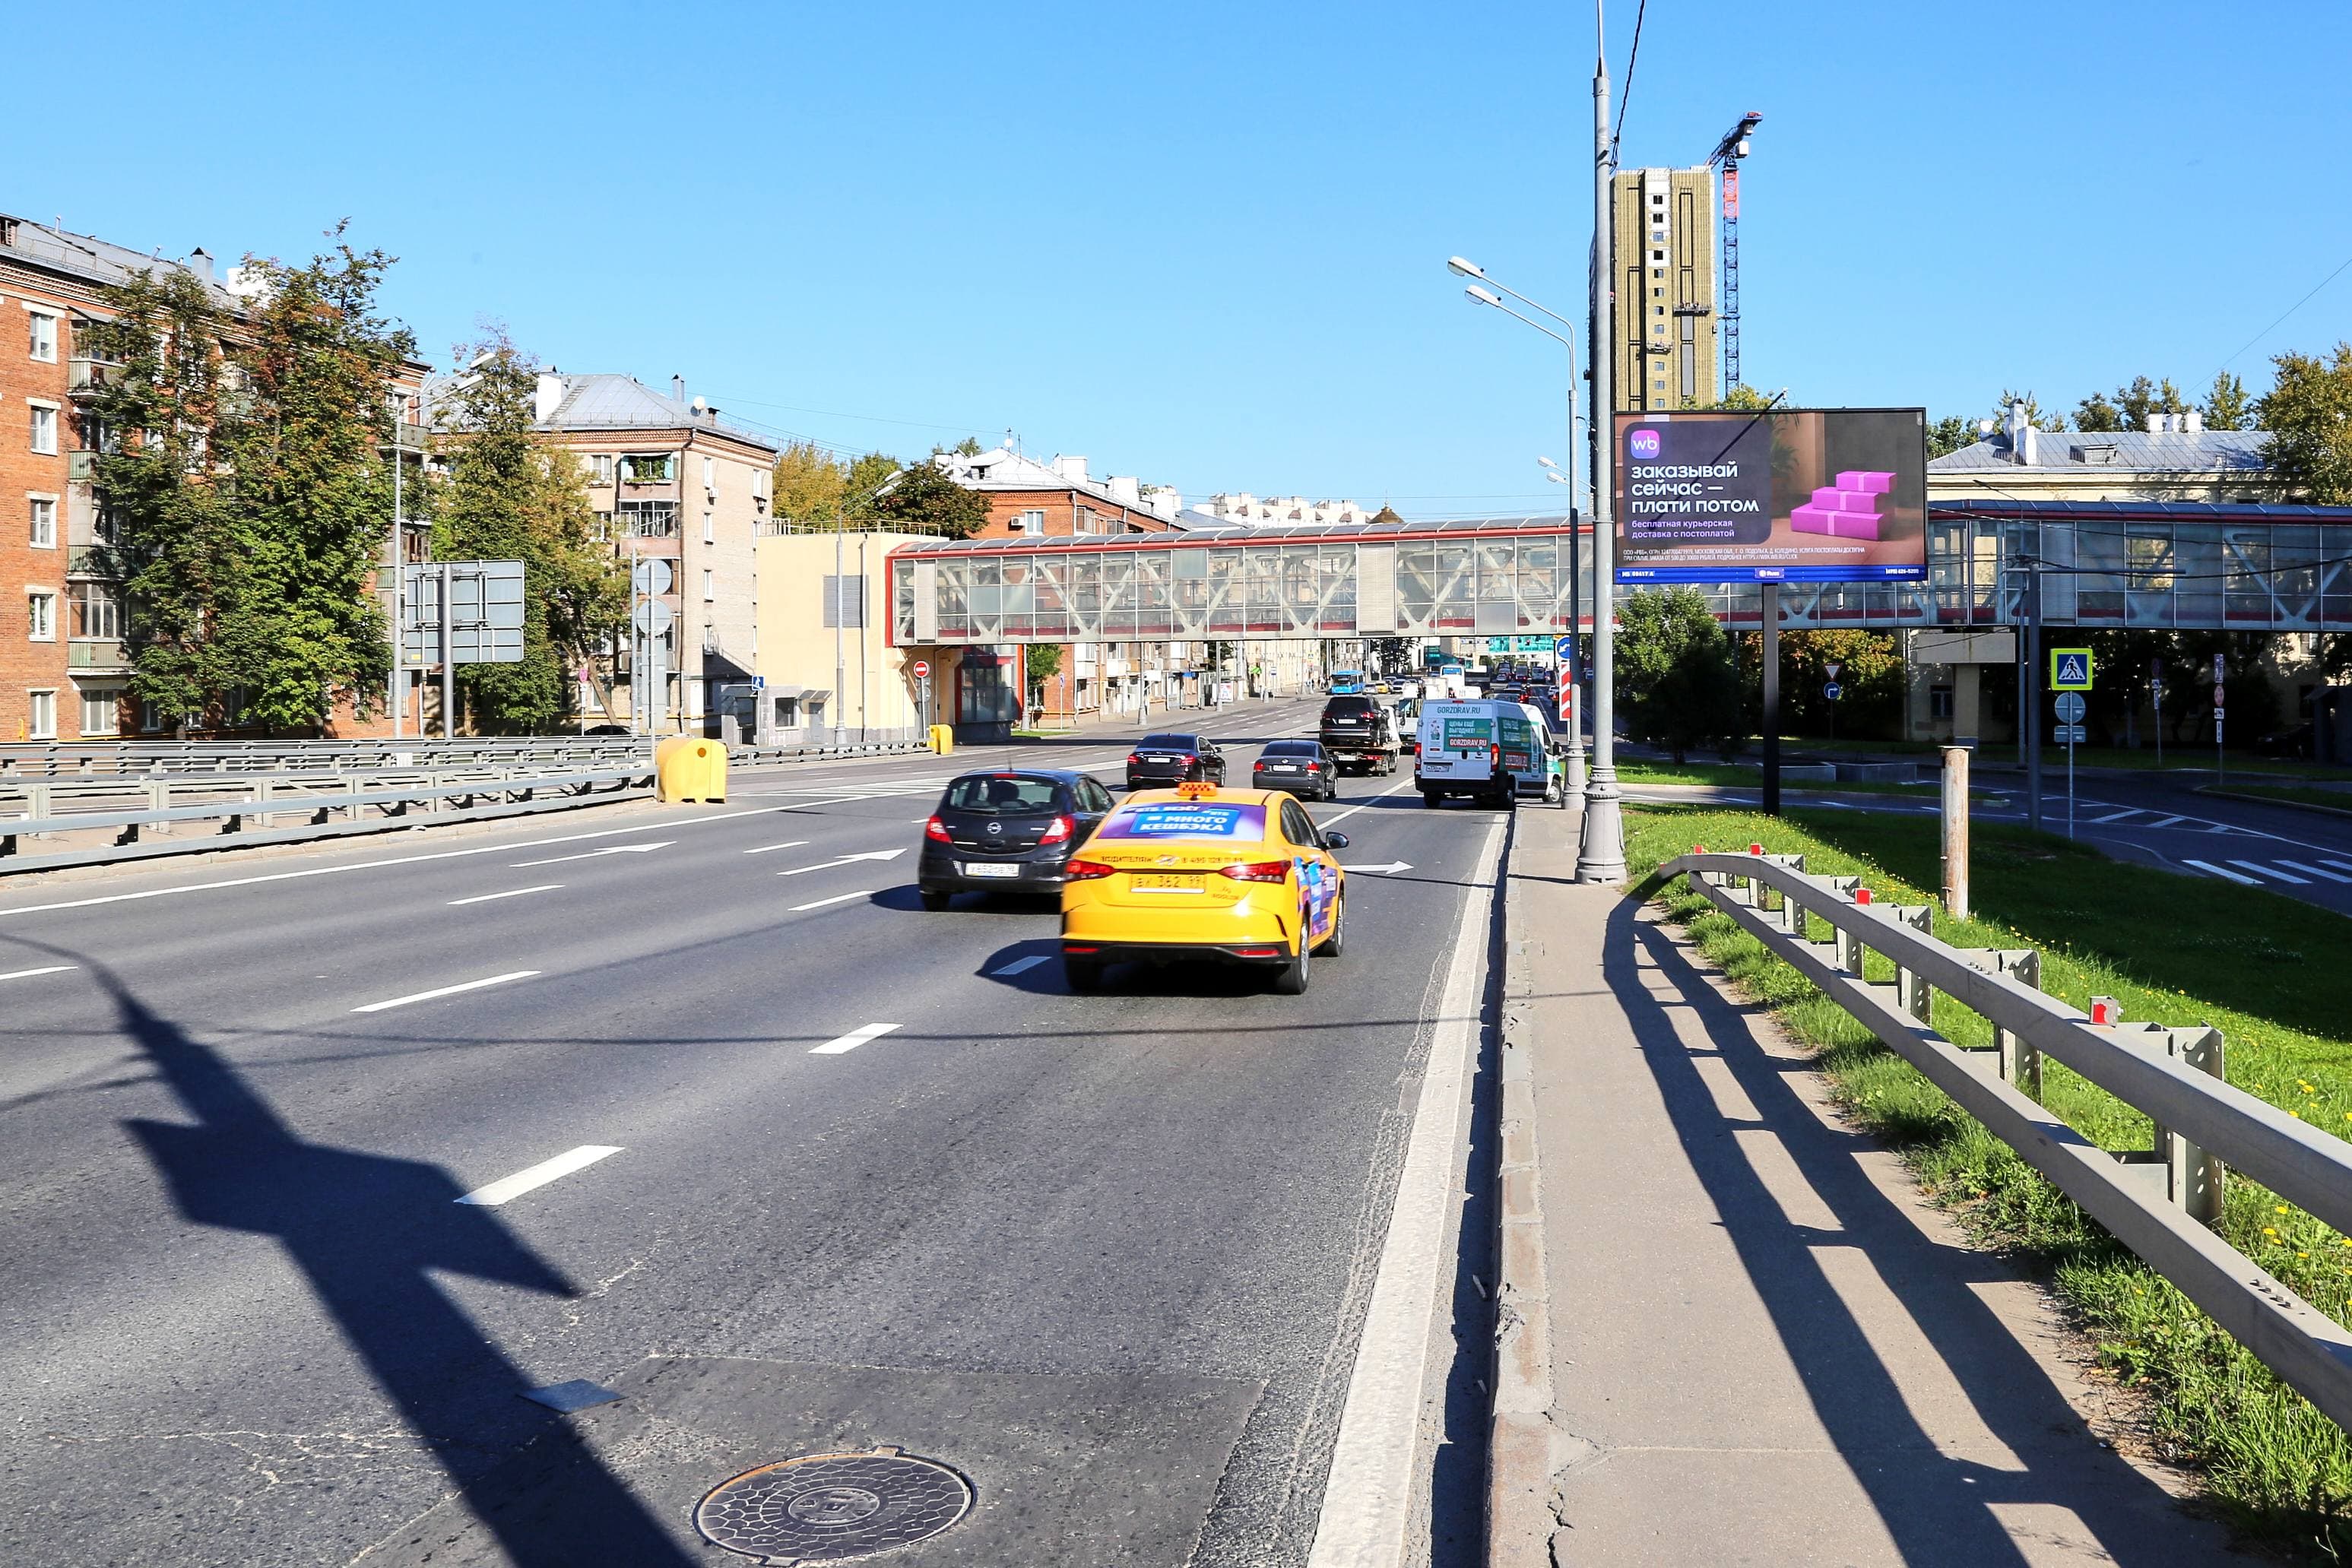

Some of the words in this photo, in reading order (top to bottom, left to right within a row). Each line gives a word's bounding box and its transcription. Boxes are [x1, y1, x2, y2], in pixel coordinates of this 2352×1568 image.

[1633, 436, 1658, 451] wb
[1631, 460, 1739, 479] заказывай
[1631, 479, 1703, 496] сейчас
[1631, 500, 1691, 514] плати
[1695, 499, 1760, 513] потом
[1631, 520, 1681, 528] бесплатная
[1683, 520, 1732, 529] курьерская
[1631, 531, 1672, 539] доставка
[1680, 529, 1735, 537] постоплатой
[1164, 816, 1228, 824] МНОГО
[1140, 822, 1225, 832] КЕШБЭКА
